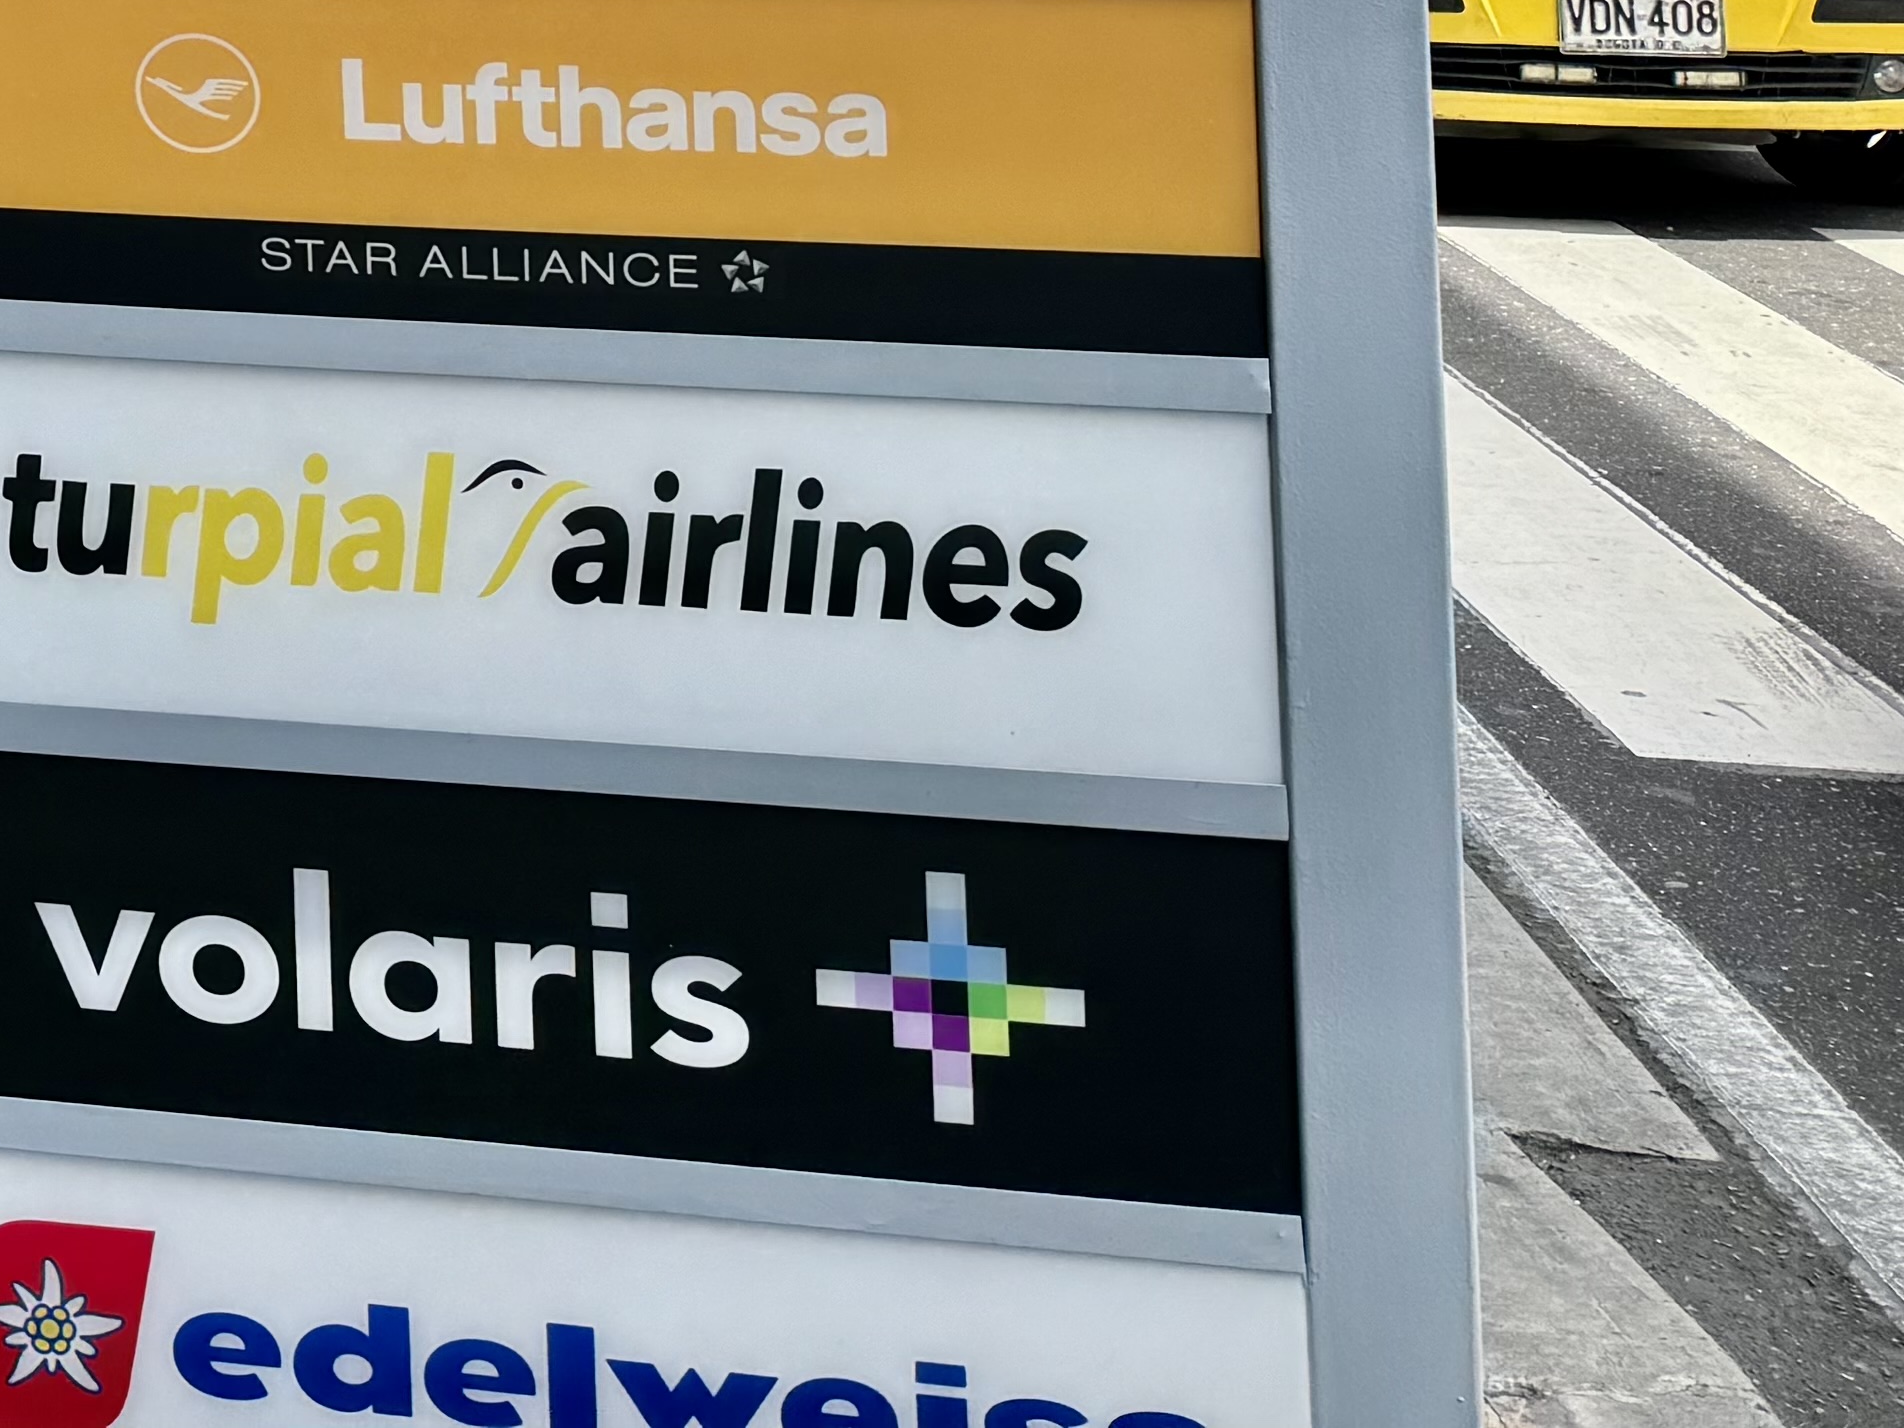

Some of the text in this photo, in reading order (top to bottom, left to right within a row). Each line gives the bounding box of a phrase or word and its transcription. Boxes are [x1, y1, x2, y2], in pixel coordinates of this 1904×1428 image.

[342, 58, 887, 158] Lufthansa
[262, 238, 697, 288] STAR ALLIANCE
[2, 451, 1088, 632] turpial airlines
[35, 868, 749, 1068] volaris
